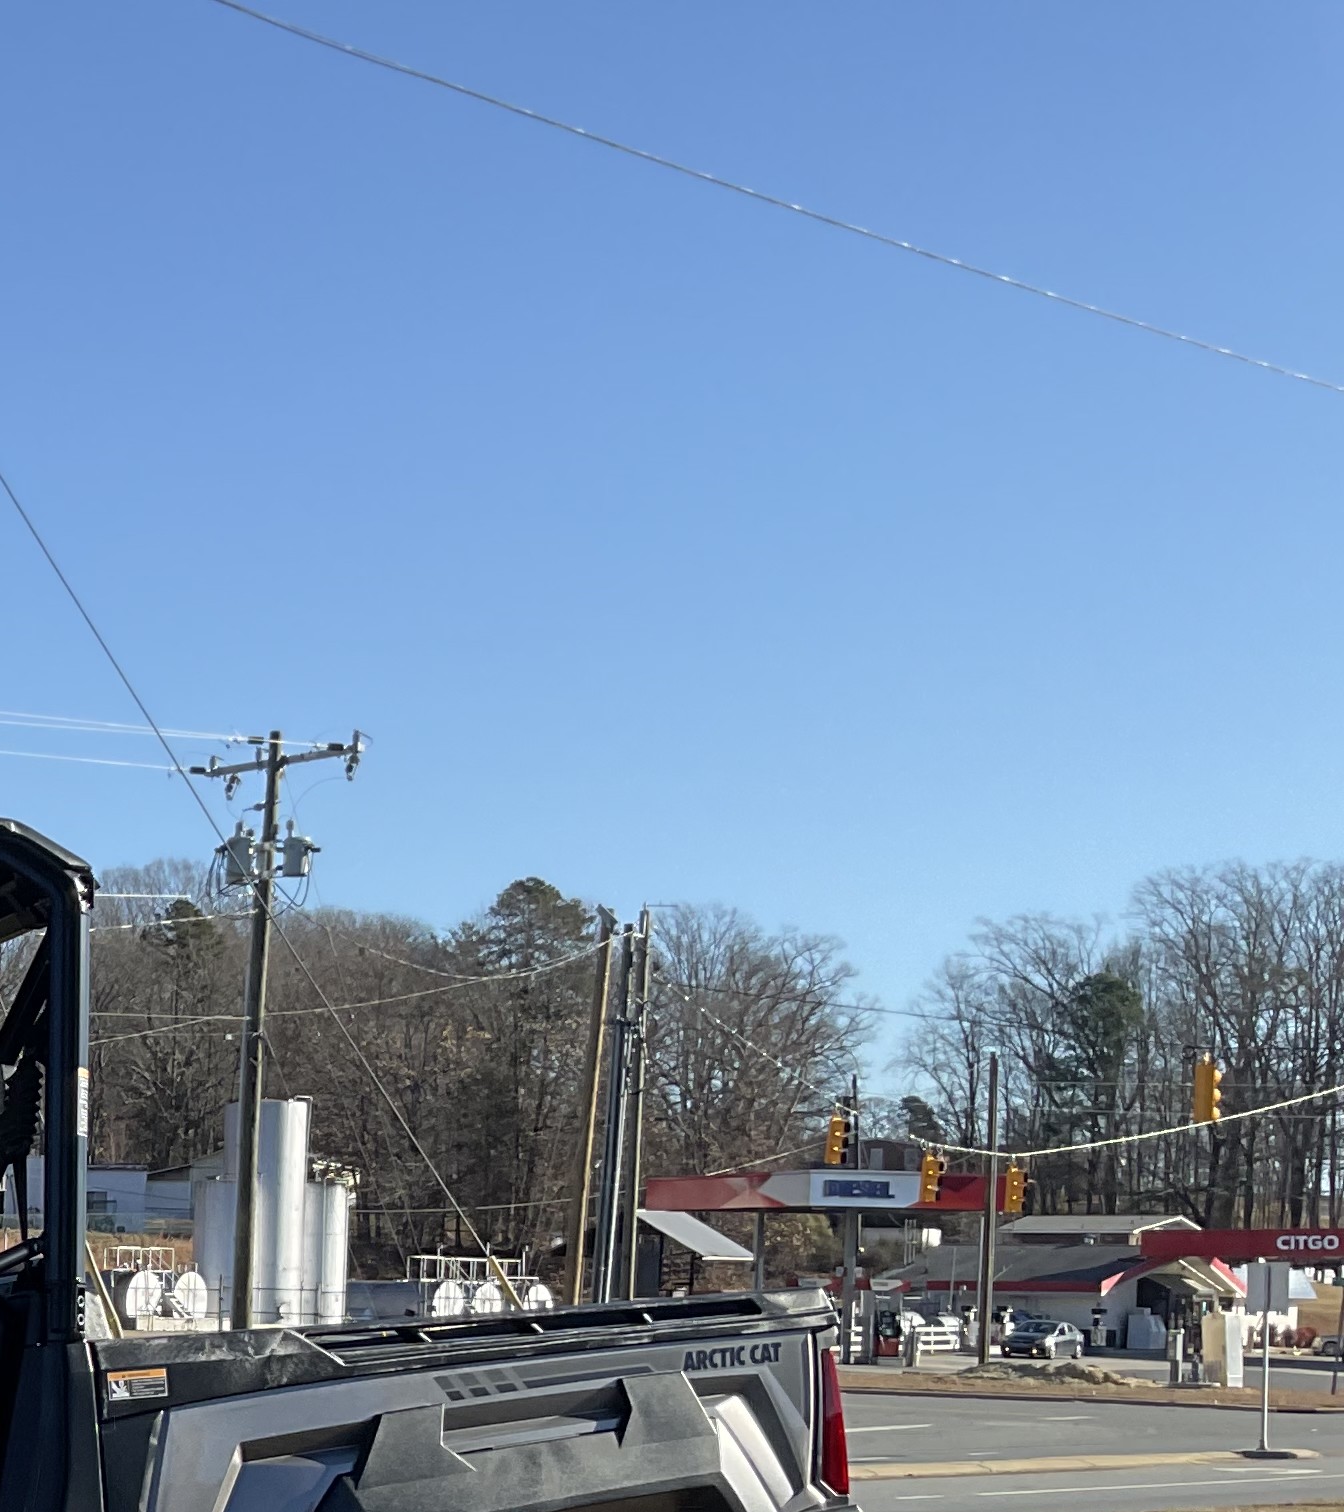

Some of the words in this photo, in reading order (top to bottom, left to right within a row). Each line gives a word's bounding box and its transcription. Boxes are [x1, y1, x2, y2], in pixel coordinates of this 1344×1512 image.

[1275, 1235, 1340, 1250] CITGO
[682, 1345, 746, 1372] ARCTIC
[750, 1342, 782, 1365] CAT
